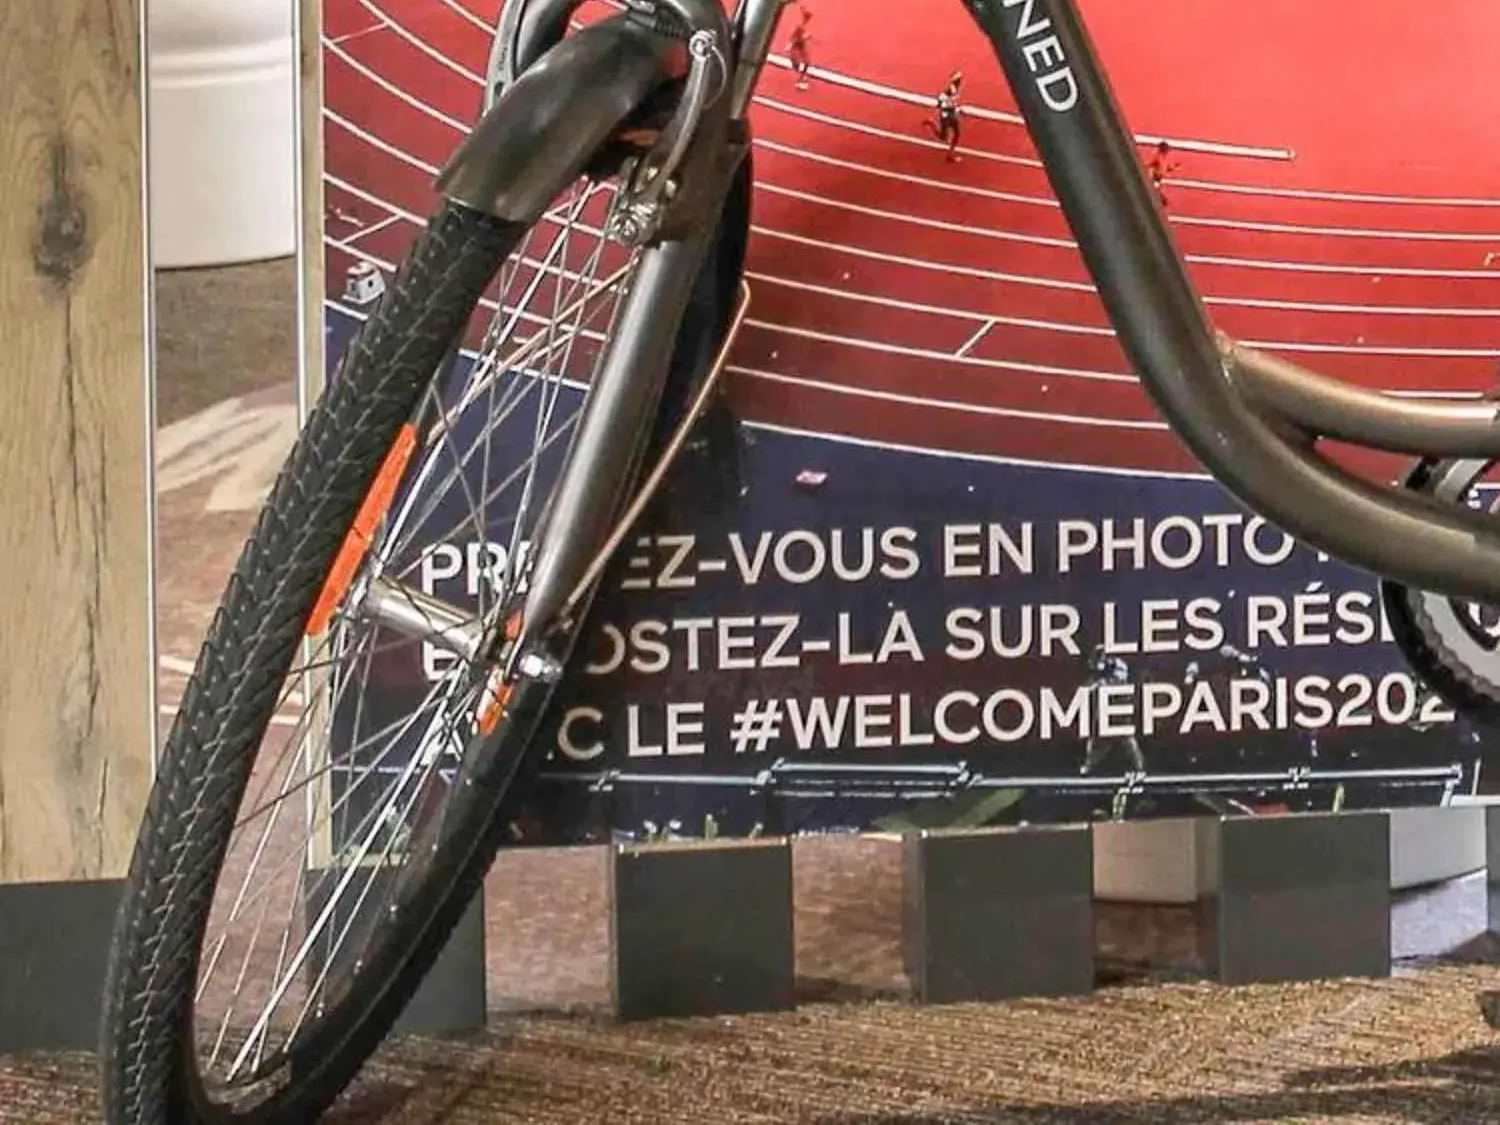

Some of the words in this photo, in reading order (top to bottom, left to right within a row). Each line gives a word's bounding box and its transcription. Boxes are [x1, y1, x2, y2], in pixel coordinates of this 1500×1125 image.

[944, 522, 1033, 577] EN
[1058, 513, 1296, 574] PHOTO
[586, 610, 925, 676] OSTEZ-LA
[945, 603, 1081, 660] SUR
[1103, 597, 1224, 653] LES
[627, 702, 706, 758] LE
[730, 671, 1456, 754] #WELCOMEPARIS202
